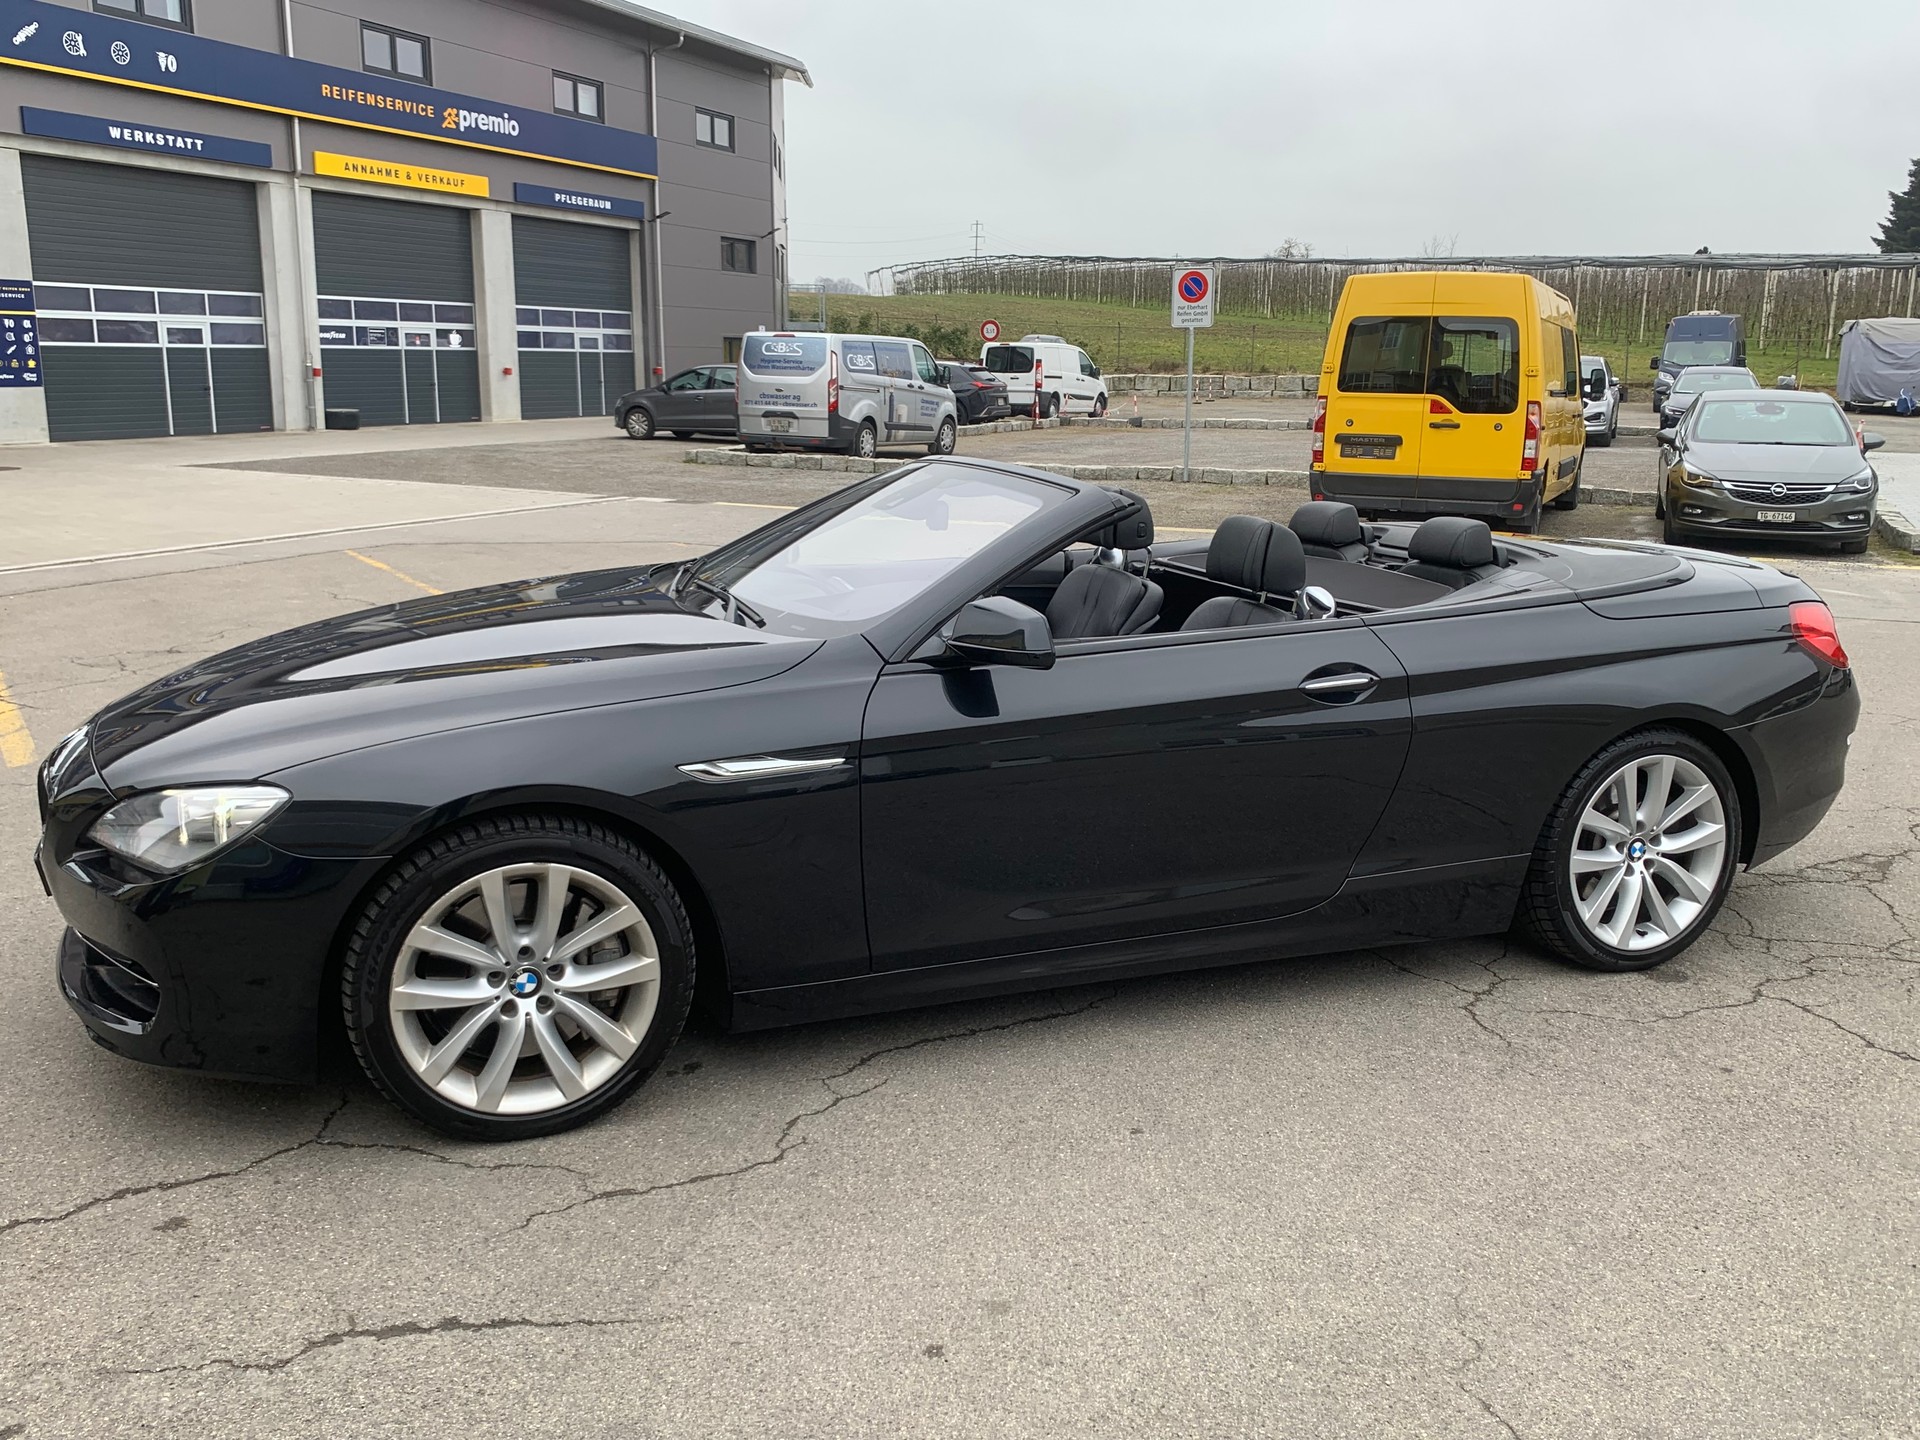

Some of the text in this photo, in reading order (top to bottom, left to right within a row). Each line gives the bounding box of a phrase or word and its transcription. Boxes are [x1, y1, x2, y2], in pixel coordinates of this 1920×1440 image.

[321, 84, 520, 137] REIFENSERVICE premio
[108, 125, 204, 151] WERKSTATT
[343, 162, 467, 188] ANNAHME & VERKAUF
[553, 192, 613, 210] PFLEGERAUM
[759, 392, 791, 400] cbswasser
